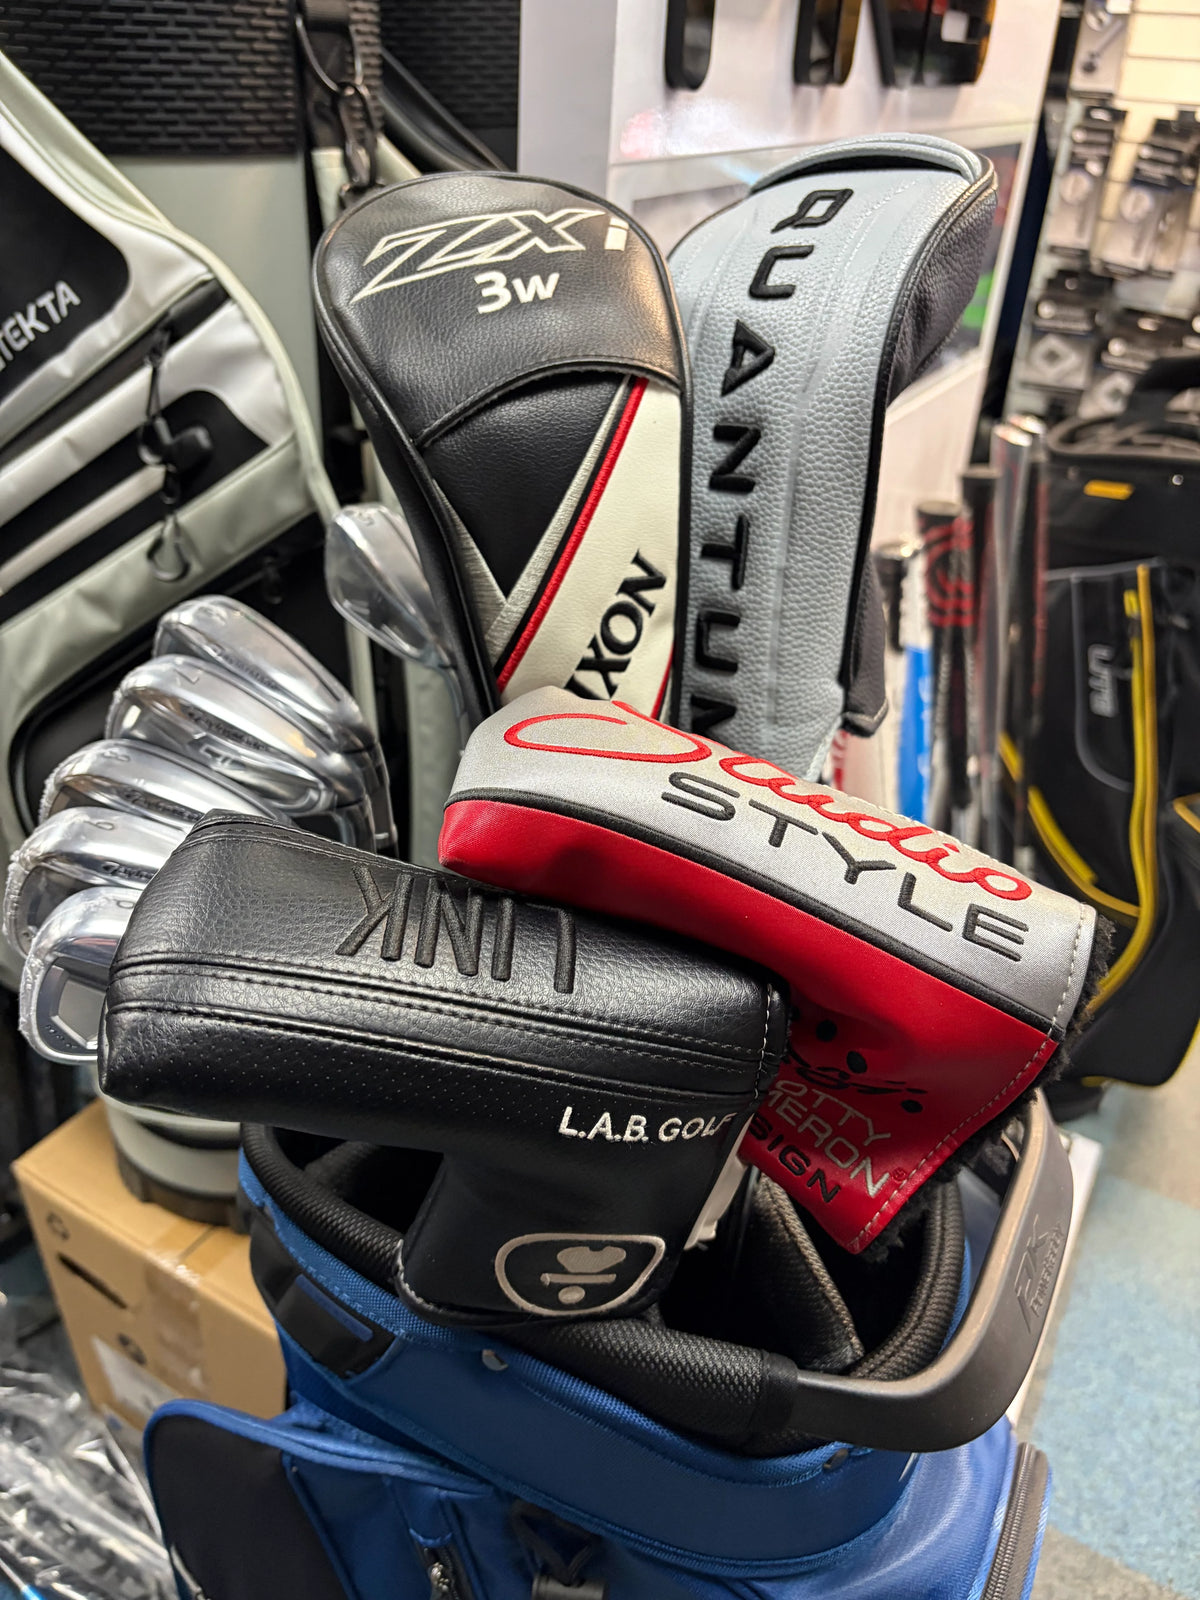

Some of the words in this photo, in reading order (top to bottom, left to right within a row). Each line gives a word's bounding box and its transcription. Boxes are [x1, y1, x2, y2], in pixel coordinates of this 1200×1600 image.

[0, 280, 81, 371] TEKTA
[504, 699, 1034, 902] Studio
[660, 770, 1030, 963] STYLE
[657, 1111, 738, 1144] GOLF
